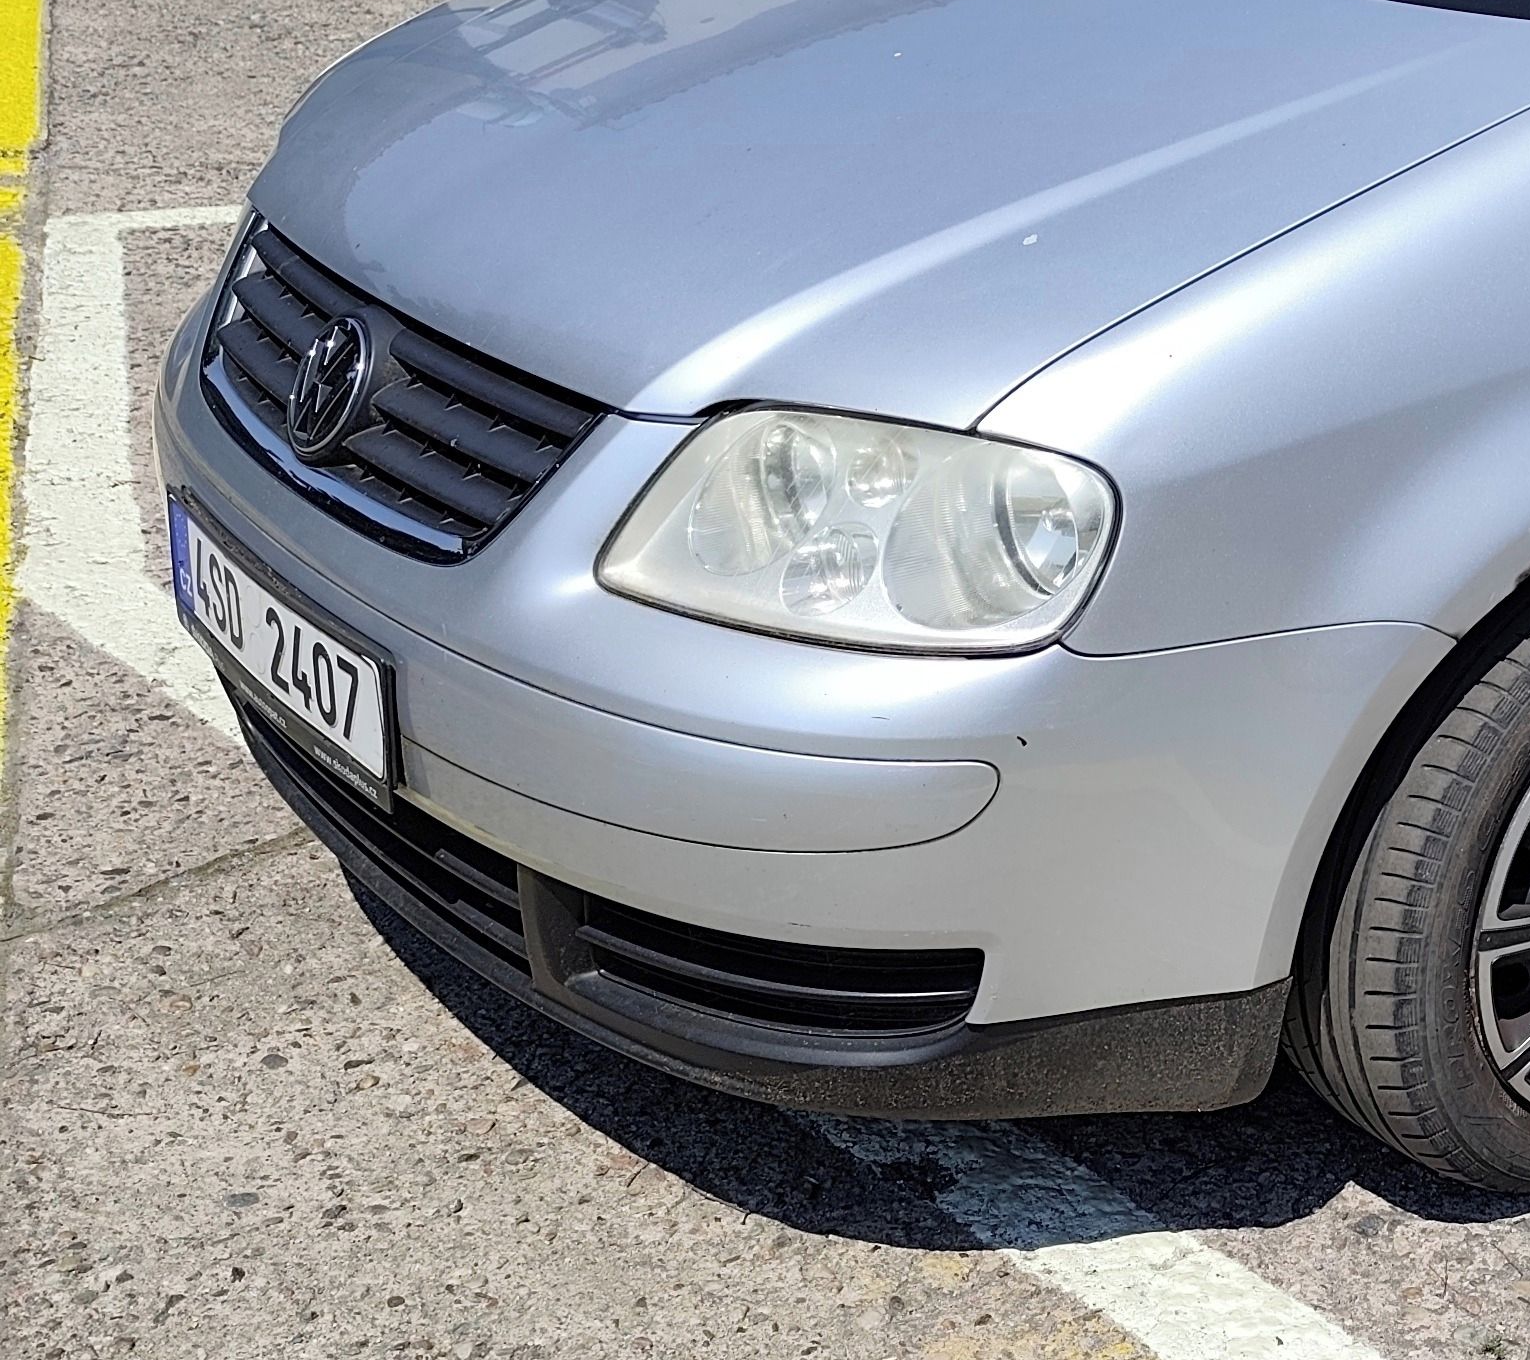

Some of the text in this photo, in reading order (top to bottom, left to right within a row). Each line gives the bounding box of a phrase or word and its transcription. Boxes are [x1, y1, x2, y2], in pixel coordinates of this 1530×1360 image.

[180, 567, 193, 597] CZ
[196, 537, 244, 650] 4SD
[265, 606, 359, 741] 2407
